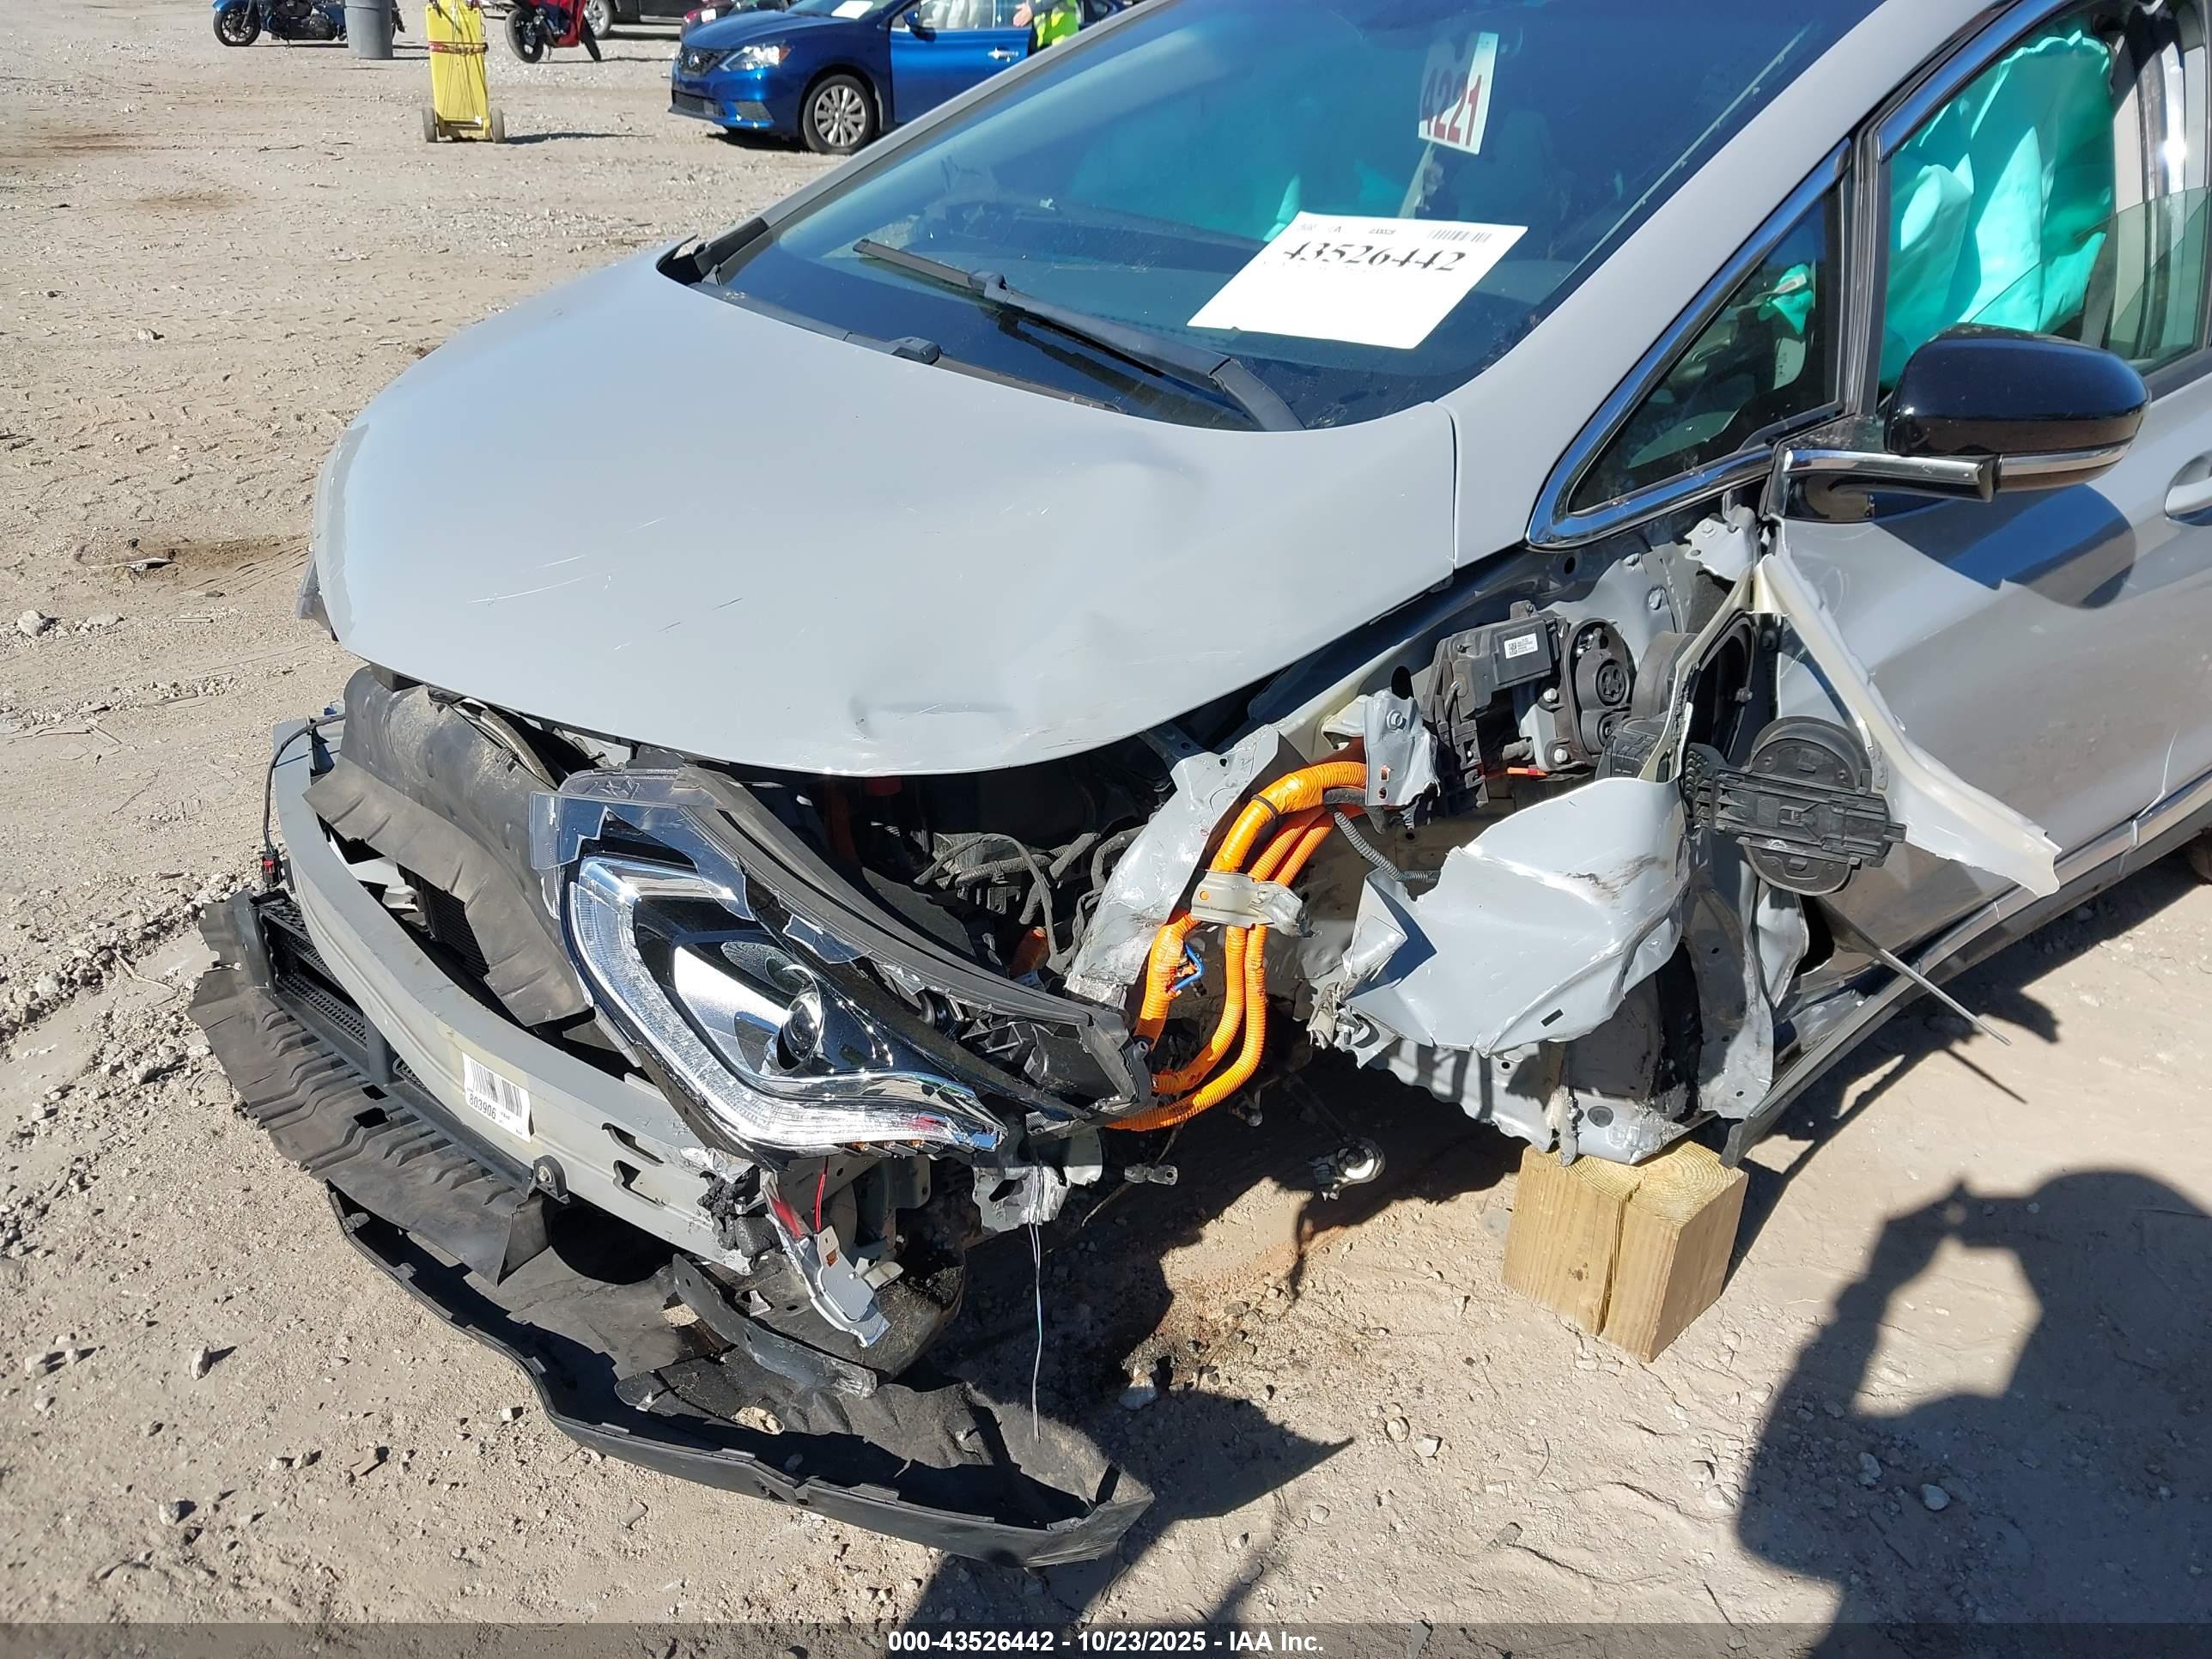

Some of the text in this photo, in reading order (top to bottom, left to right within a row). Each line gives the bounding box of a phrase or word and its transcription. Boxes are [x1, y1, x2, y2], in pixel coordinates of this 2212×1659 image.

[1421, 68, 1483, 147] 4221
[1284, 240, 1467, 272] 43526442
[469, 1093, 497, 1120] 803906
